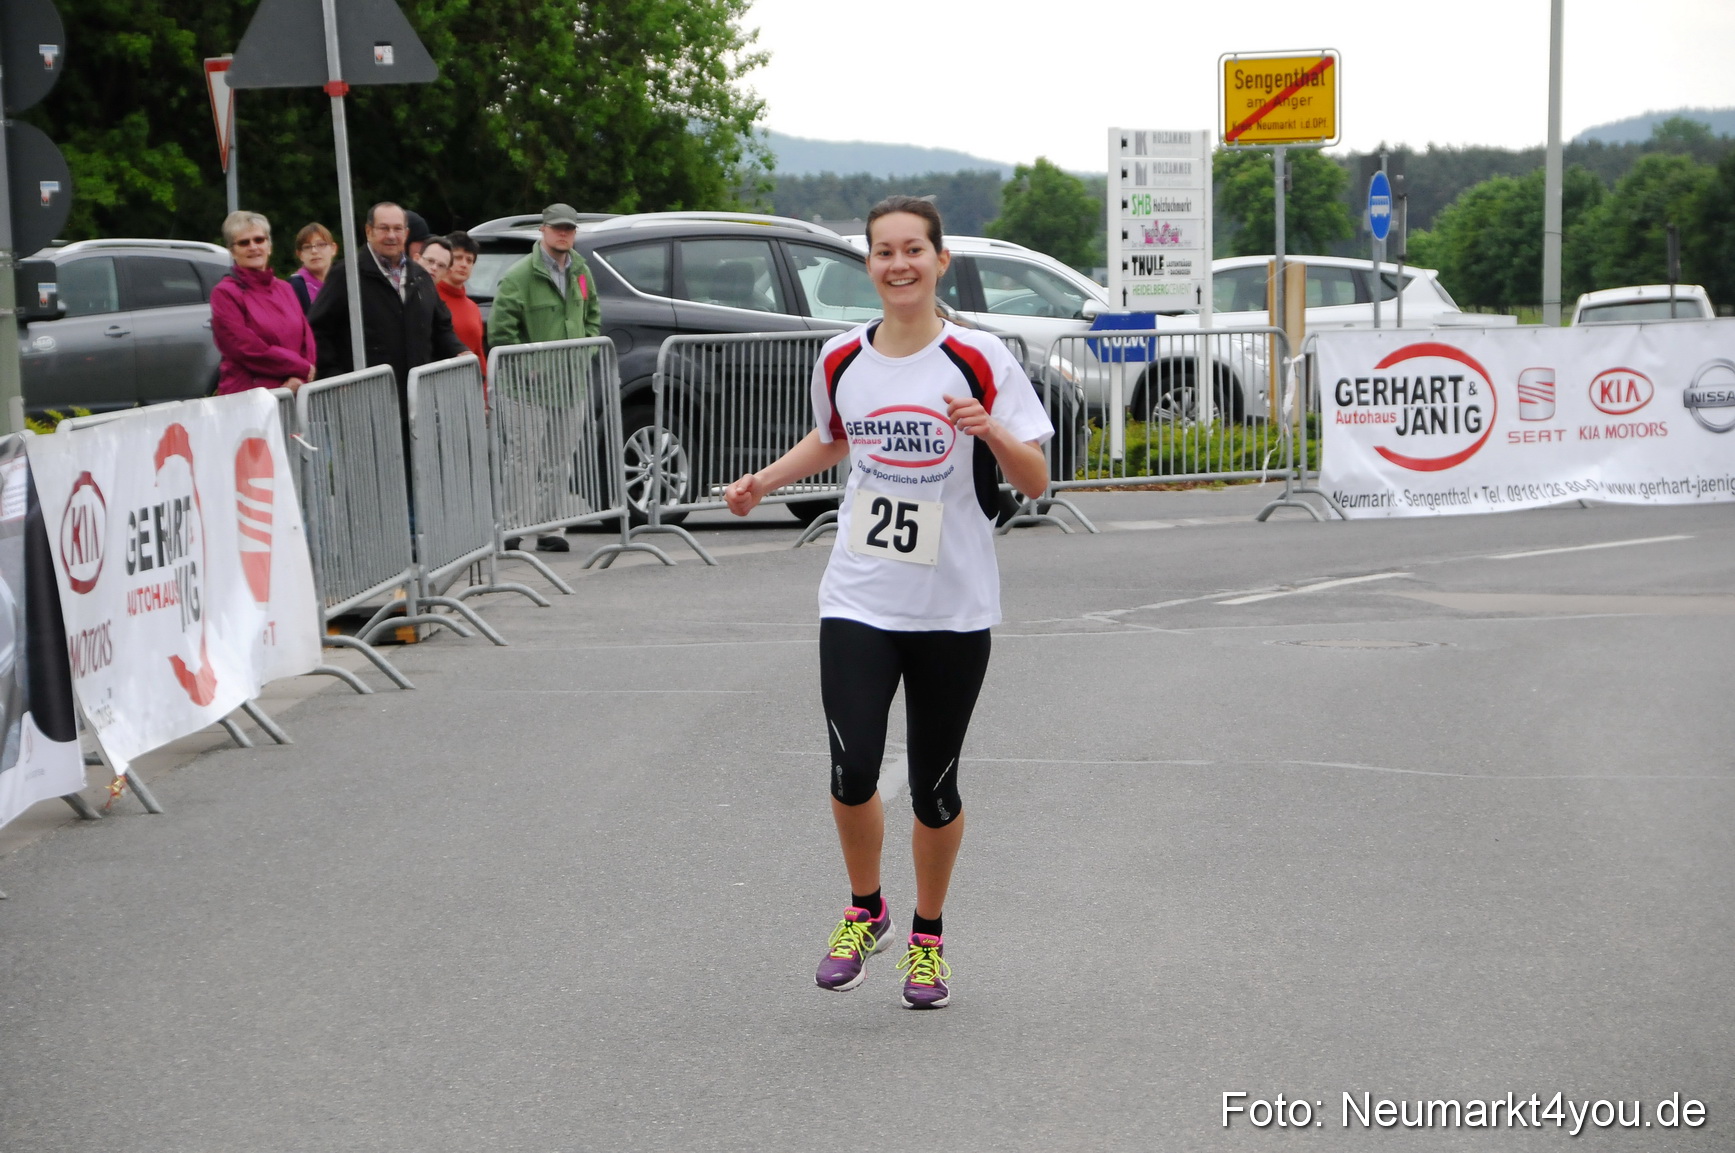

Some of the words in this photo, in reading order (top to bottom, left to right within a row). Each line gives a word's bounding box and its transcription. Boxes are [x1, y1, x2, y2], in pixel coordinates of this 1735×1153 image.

[1235, 66, 1326, 94] Sengenthal
[1246, 98, 1267, 109] am
[1273, 95, 1313, 110] Anger
[1256, 118, 1297, 131] Neumarkt
[1131, 193, 1152, 216] SHB
[1131, 254, 1165, 276] THULE
[1335, 375, 1464, 407] GERHART
[1468, 380, 1478, 396] &
[1600, 378, 1643, 405] KIA
[846, 420, 932, 437] GERHART
[935, 427, 944, 436] &
[1335, 409, 1397, 425] Autohaus
[1395, 404, 1483, 436] JÄNIG
[1579, 425, 1600, 441] KIA
[1605, 421, 1668, 439] MOTORS
[881, 436, 945, 454] JÄNIG
[1508, 429, 1567, 444] SEAT
[857, 459, 872, 474] Das
[873, 468, 918, 484] sportliche
[1332, 489, 1398, 509] Neumarkt
[1404, 487, 1472, 510] Sengenthal
[1482, 485, 1504, 504] Tel.
[866, 496, 919, 553] 25
